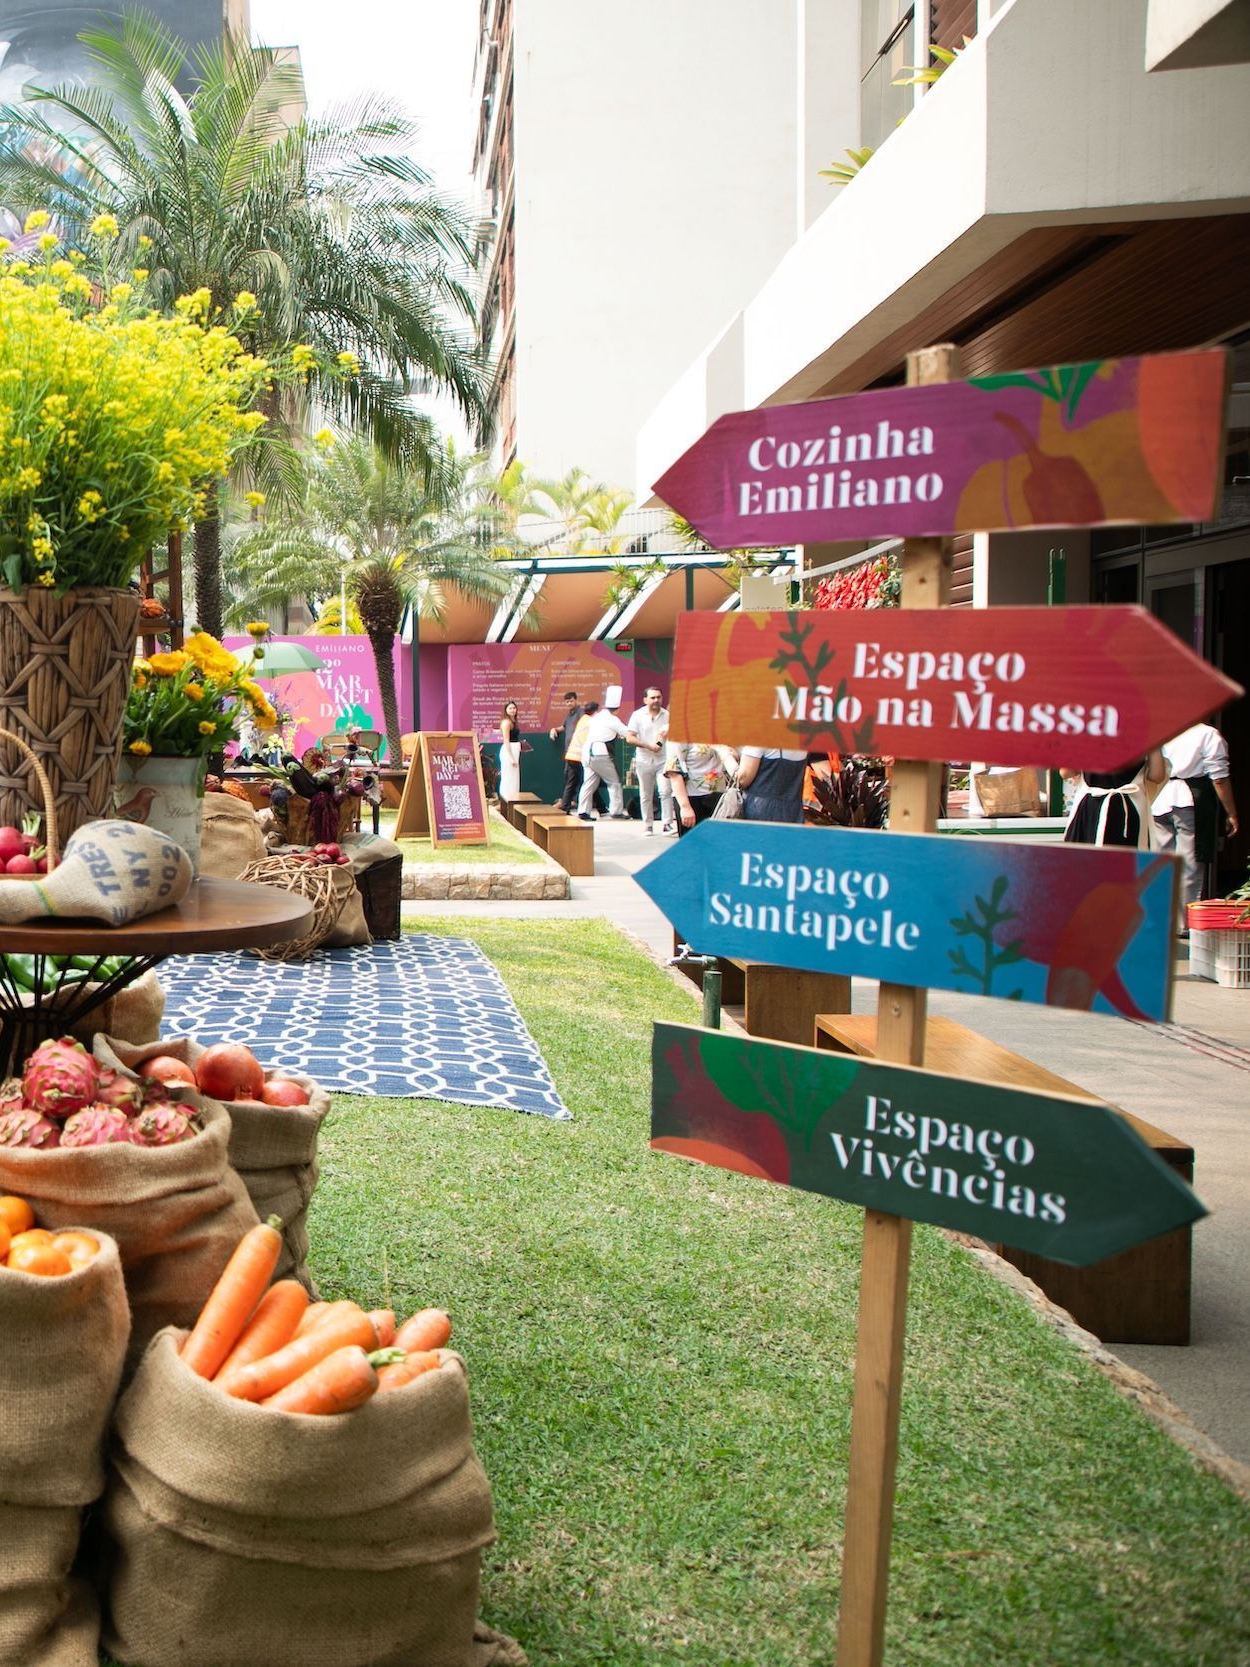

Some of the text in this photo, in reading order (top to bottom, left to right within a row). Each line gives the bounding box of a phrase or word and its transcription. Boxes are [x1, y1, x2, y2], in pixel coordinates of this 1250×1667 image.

[749, 420, 935, 472] Cozinha
[738, 469, 944, 517] Emiliano
[316, 674, 361, 690] MAR
[853, 642, 1026, 695] Espaço
[320, 703, 357, 718] DAY
[334, 688, 374, 704] KET
[772, 684, 1120, 738] Mão na Massa
[739, 852, 890, 909] Espaço
[709, 892, 921, 951] Santapele
[864, 1095, 1035, 1170] Espaço
[830, 1131, 1067, 1225] Vivências
